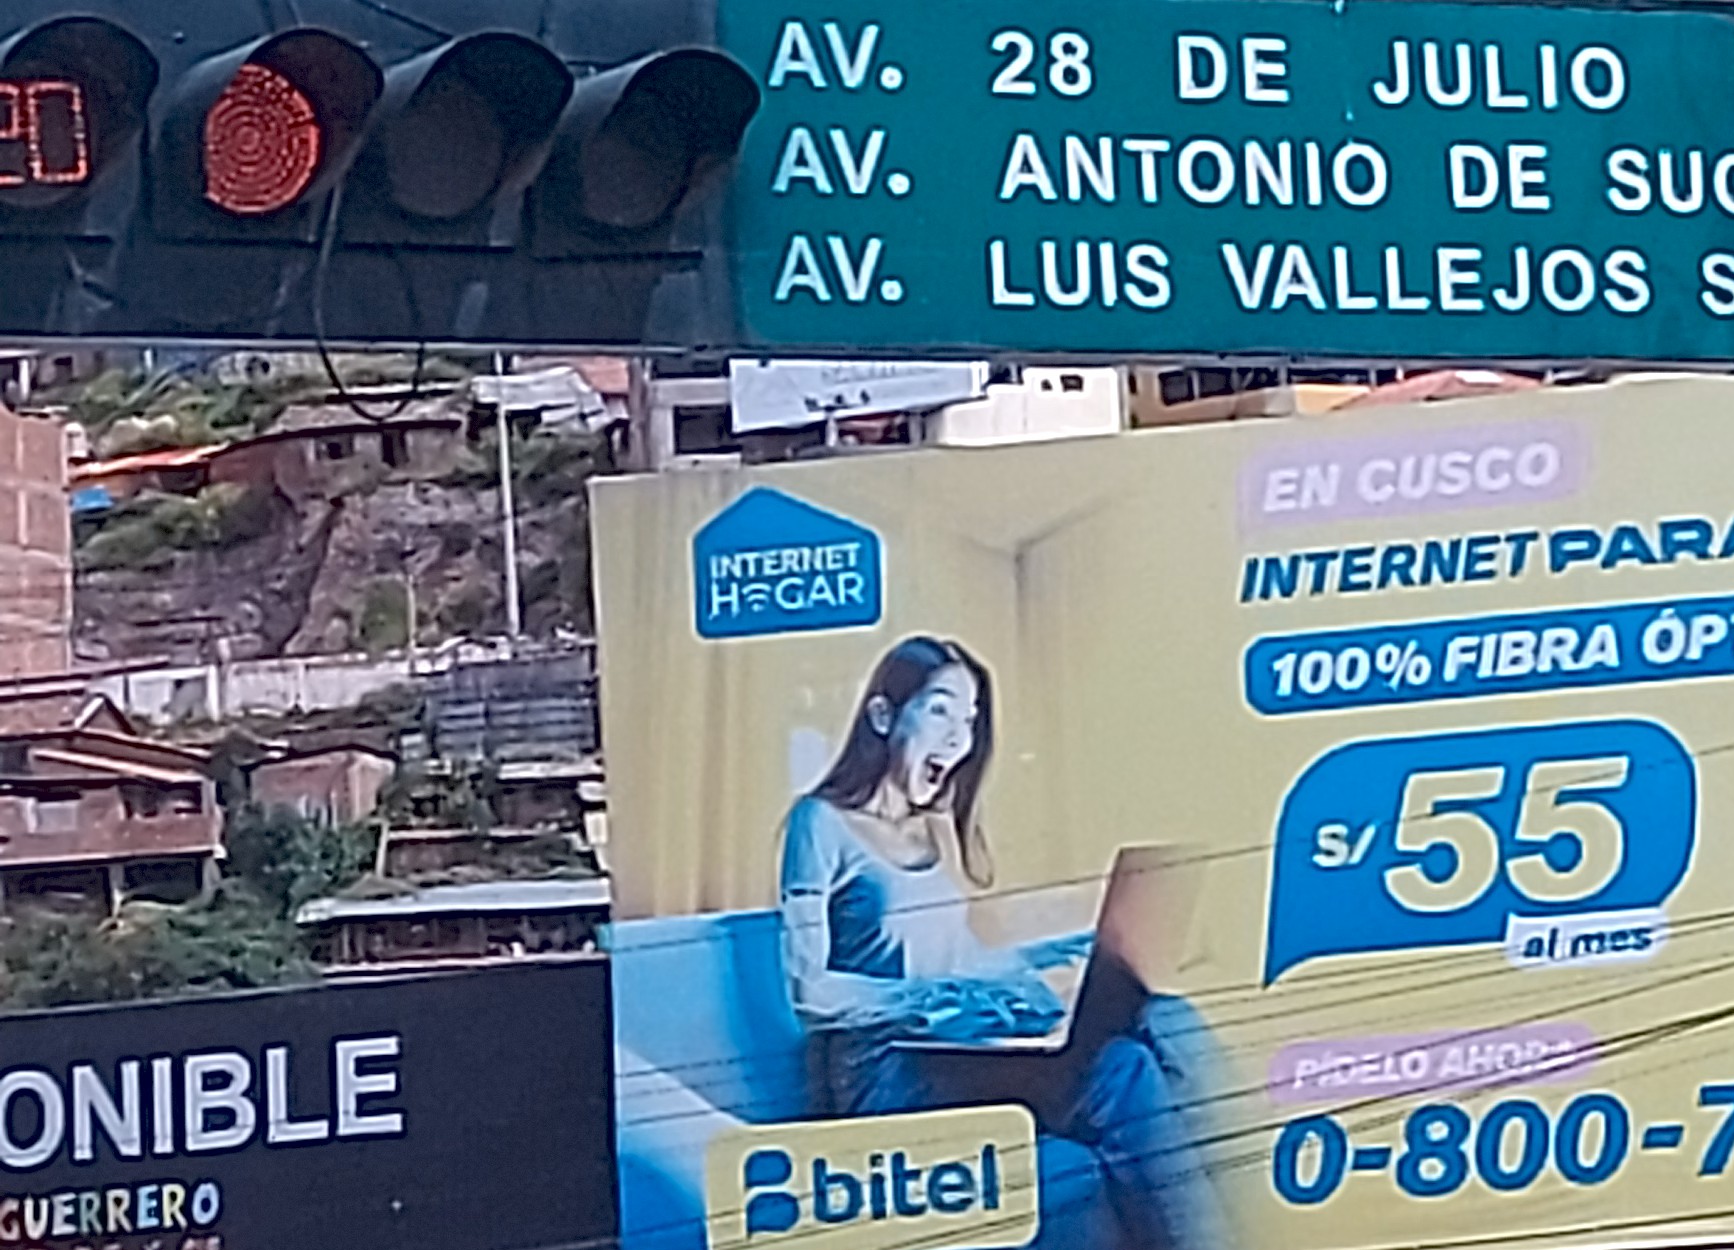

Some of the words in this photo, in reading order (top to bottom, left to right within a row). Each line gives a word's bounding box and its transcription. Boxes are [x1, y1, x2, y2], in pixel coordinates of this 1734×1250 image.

[768, 21, 905, 90] AV.
[991, 32, 1093, 97] 28
[1177, 35, 1290, 102] DE
[1372, 39, 1627, 110] JULIO
[772, 127, 912, 196] AV.
[1000, 133, 1387, 207] ANTONIO
[1449, 144, 1551, 210] DE
[774, 235, 905, 303] AV.
[991, 240, 1171, 308] LUIS
[1222, 242, 1651, 312] VALLEJOS
[1264, 463, 1338, 513] EN
[1357, 442, 1561, 498] CUSCO
[710, 540, 861, 579] INTERNET
[1241, 529, 1536, 603] INTERNET
[1271, 638, 1431, 696] 100%
[1443, 623, 1619, 683] FIBRA
[1312, 822, 1377, 869] S/
[1384, 755, 1631, 914] 55
[1523, 924, 1557, 960] al
[1573, 926, 1653, 956] mes
[0, 1035, 403, 1168] ONIBLE
[0, 1182, 219, 1241] GUERRERO
[813, 1143, 999, 1224] bitel
